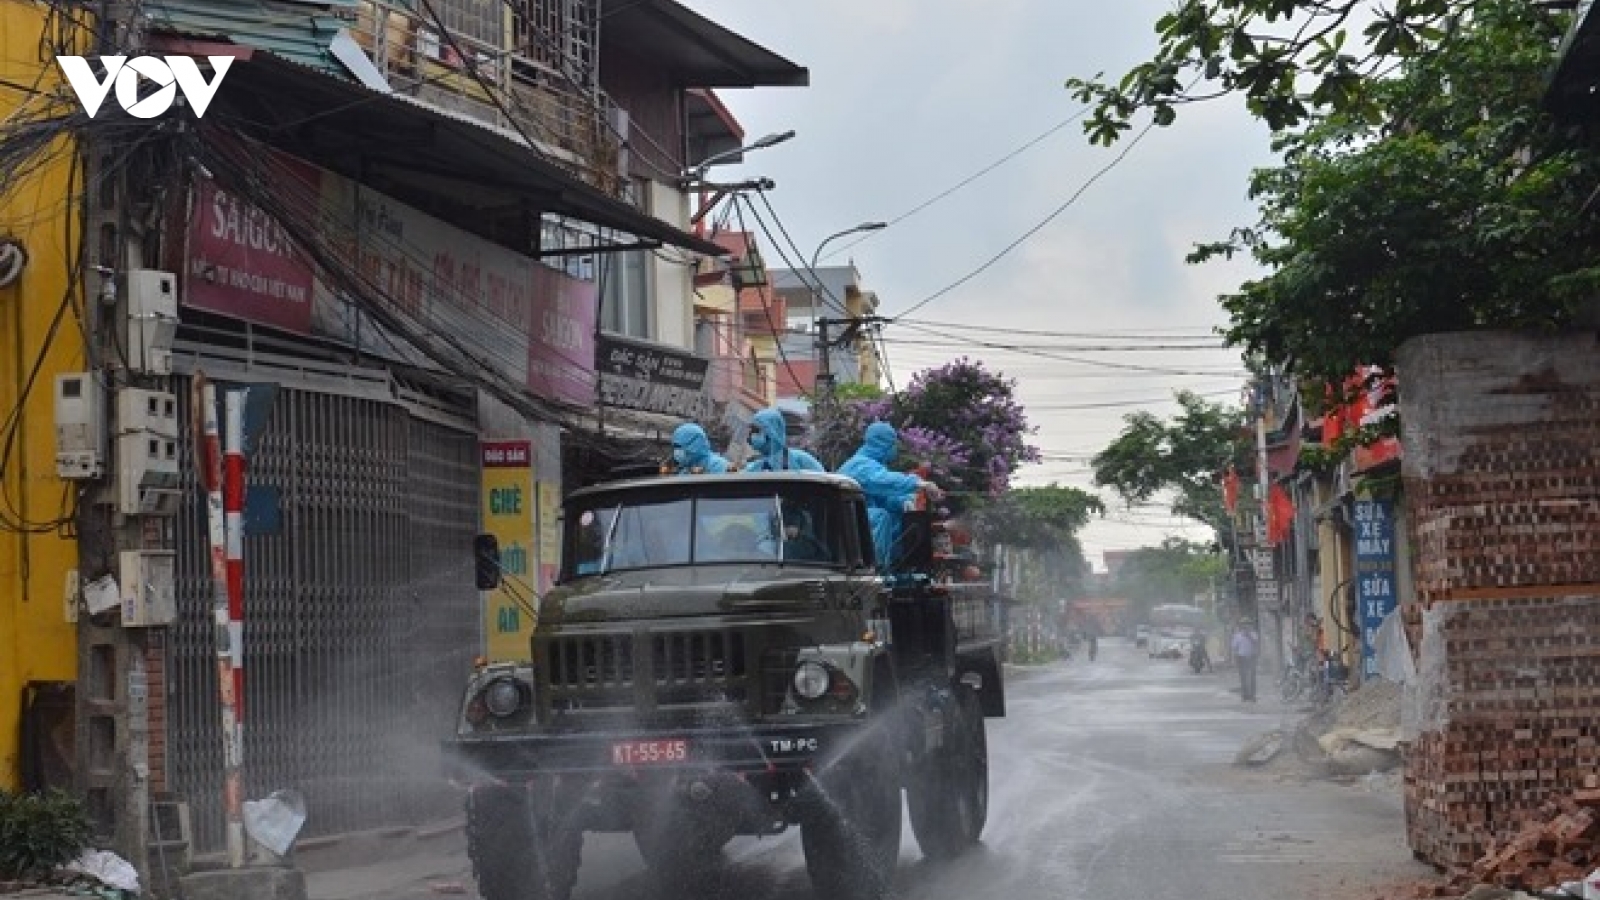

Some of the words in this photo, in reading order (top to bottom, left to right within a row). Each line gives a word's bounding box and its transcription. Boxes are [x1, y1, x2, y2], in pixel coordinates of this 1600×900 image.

[489, 484, 522, 515] CHÈ
[1361, 522, 1383, 538] XE
[1357, 537, 1390, 555] MÁY
[1362, 573, 1390, 597] SỬA
[1366, 600, 1386, 619] XE
[612, 740, 687, 764] KT-55-65
